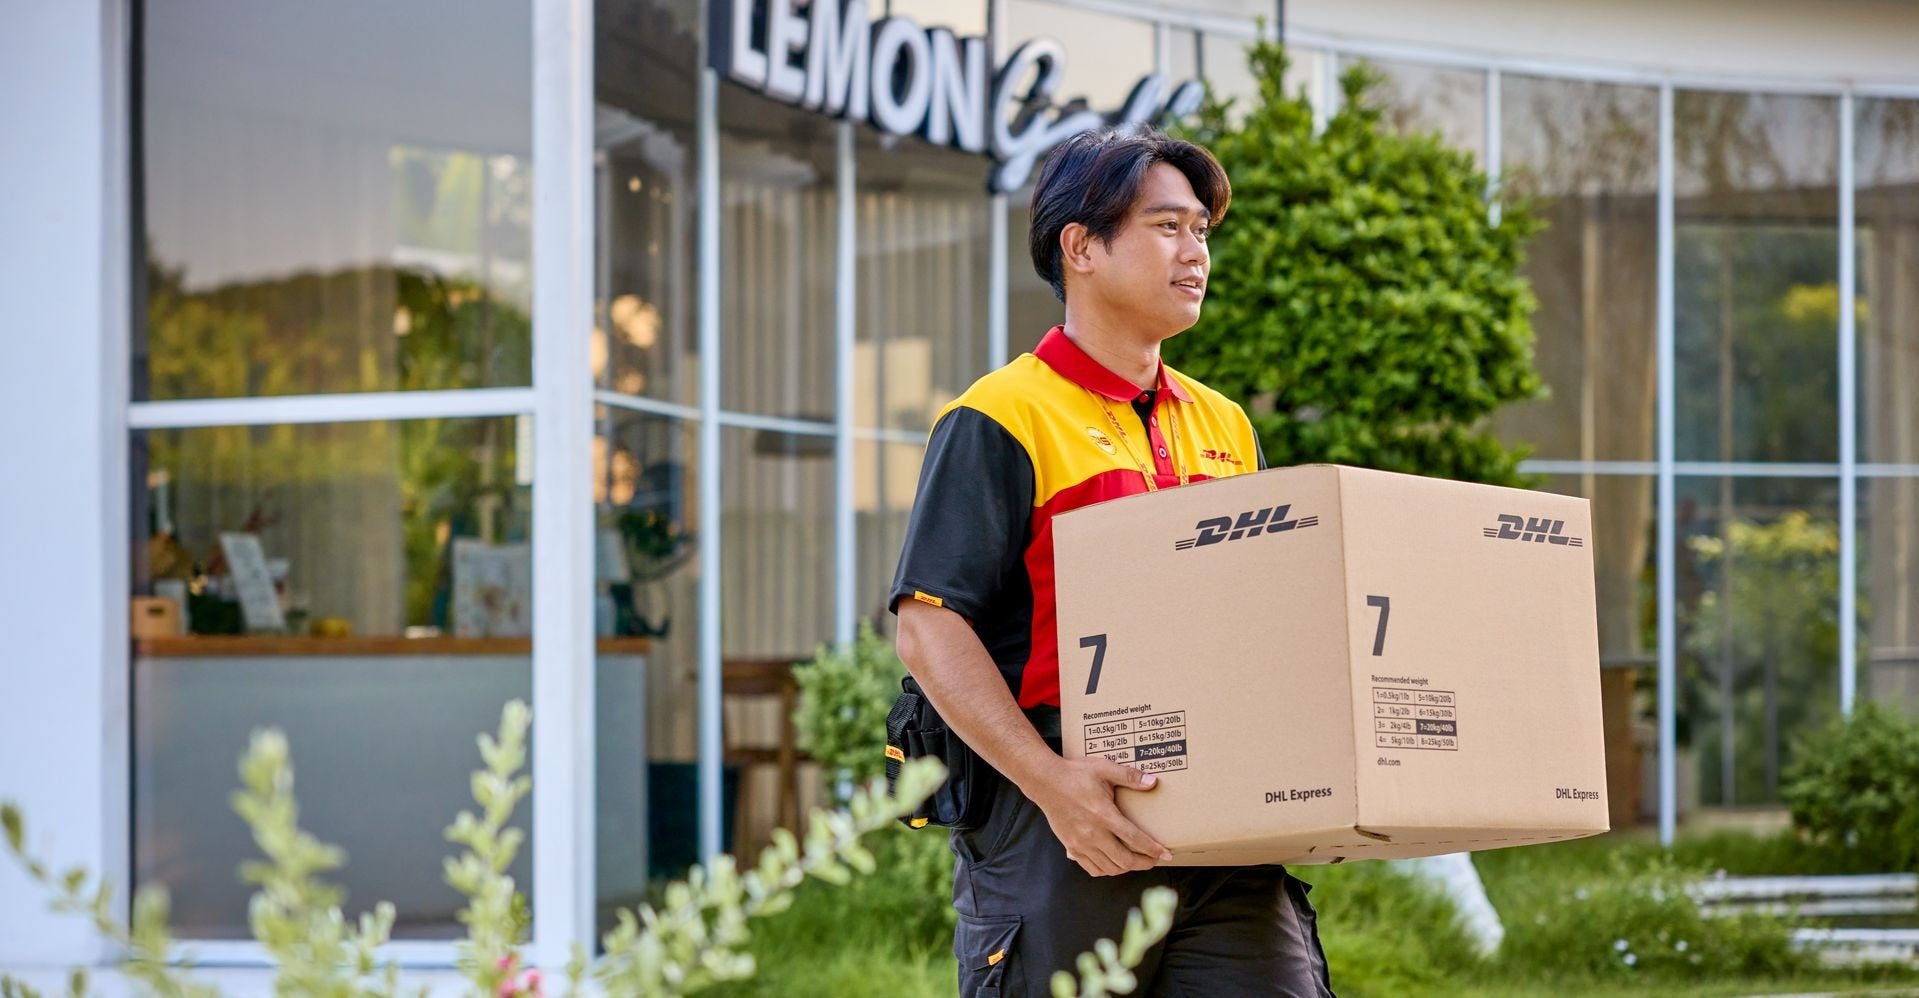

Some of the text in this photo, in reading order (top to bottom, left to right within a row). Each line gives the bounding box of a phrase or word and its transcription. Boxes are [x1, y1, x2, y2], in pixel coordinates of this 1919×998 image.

[731, 0, 985, 153] LEMON
[1194, 504, 1298, 547] DHL
[1497, 514, 1569, 546] DHL
[1366, 595, 1390, 657] 7
[1079, 634, 1107, 696] 7
[1371, 675, 1429, 687] Recommended weight
[1083, 704, 1151, 720] Recommended weight
[1088, 723, 1128, 735] 1=0.5kg/1lb
[1139, 716, 1181, 729] 5=10kg/20lb
[1139, 729, 1182, 742] 6=15kg/30lb
[1140, 743, 1183, 757] 7=20kg/40lb
[1140, 759, 1183, 771] 8=25kg/50lb
[1377, 757, 1401, 766] dhl.com
[1265, 787, 1332, 804] DHL Express
[1556, 788, 1599, 802] DHL Express
